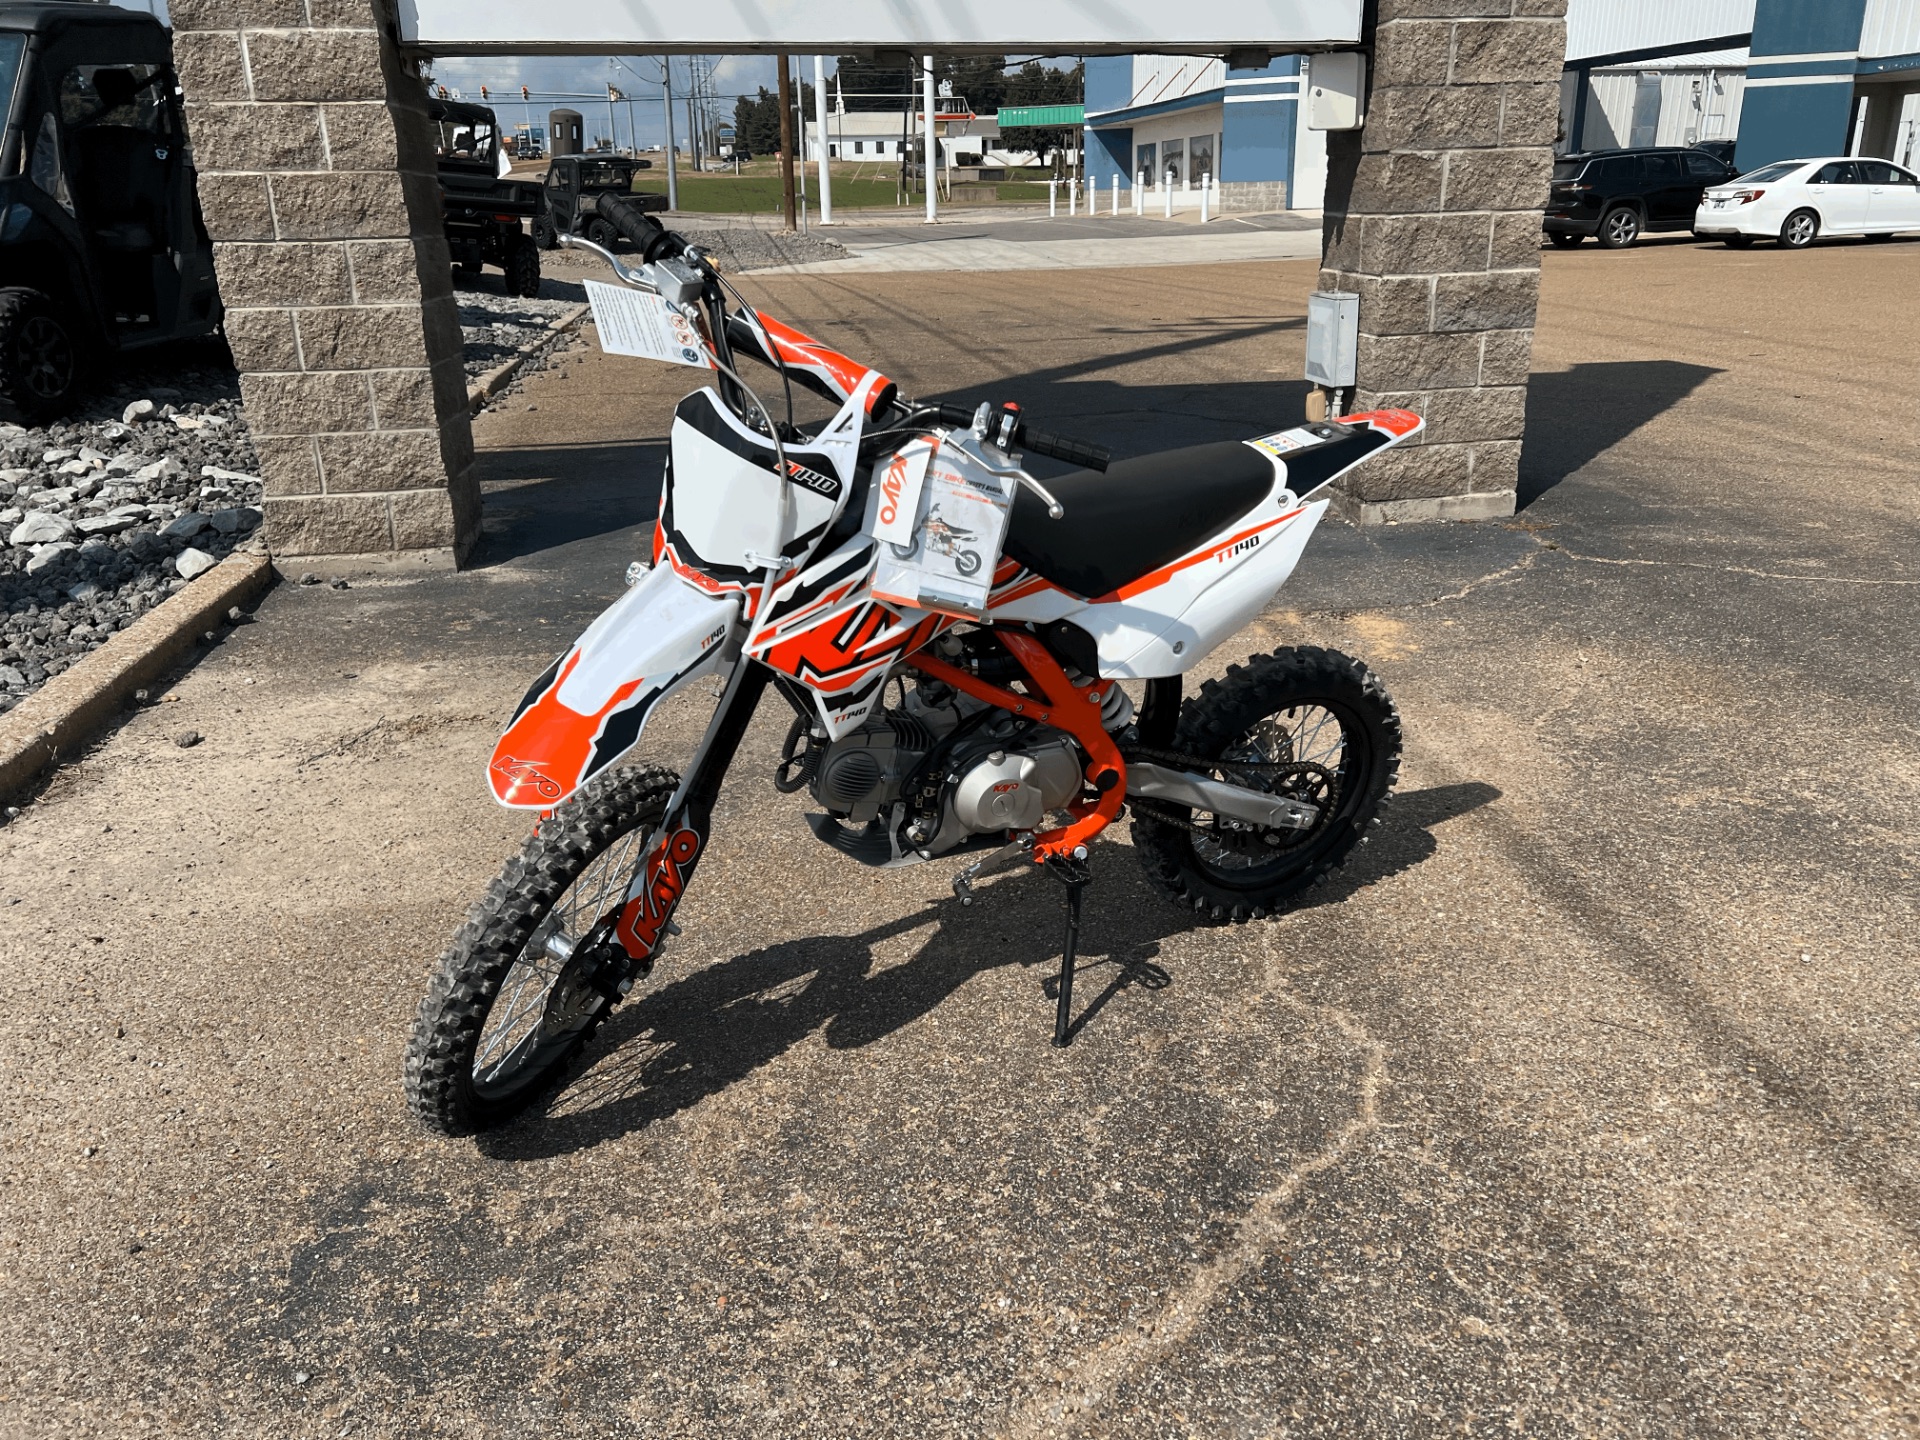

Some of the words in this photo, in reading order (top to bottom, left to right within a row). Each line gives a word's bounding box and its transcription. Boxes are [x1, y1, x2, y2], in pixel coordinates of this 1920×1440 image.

[880, 452, 908, 525] KAYO
[1216, 535, 1260, 563] TT140
[701, 624, 725, 650] TT140
[834, 706, 868, 724] TT140
[492, 755, 562, 798] KAYO
[631, 828, 700, 954] KAYO
